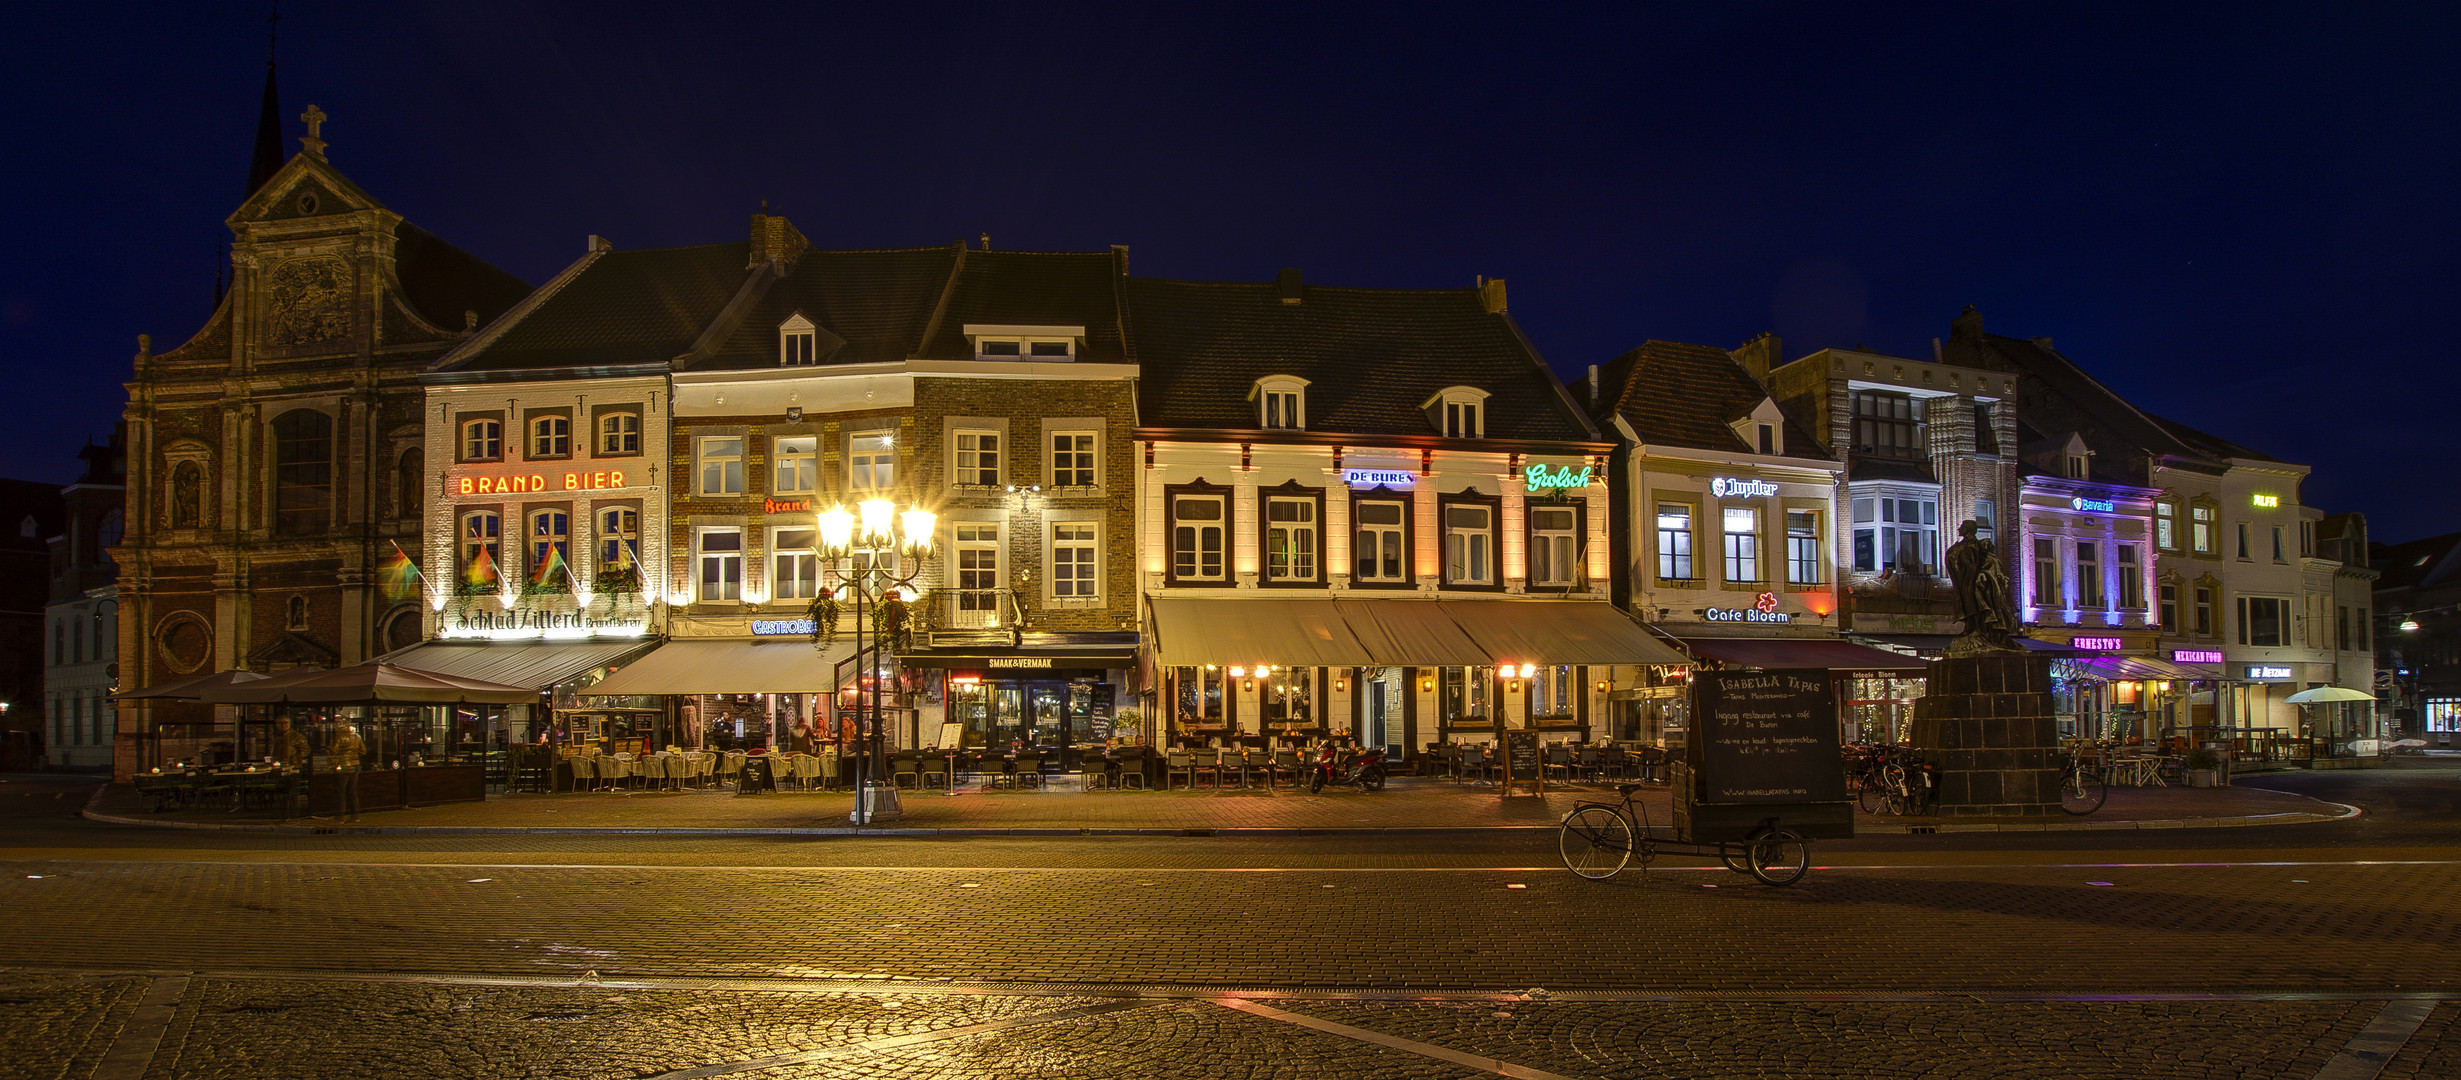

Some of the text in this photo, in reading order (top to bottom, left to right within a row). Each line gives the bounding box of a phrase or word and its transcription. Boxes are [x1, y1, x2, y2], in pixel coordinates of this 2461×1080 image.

[460, 471, 625, 494] BRAND BIER
[1350, 472, 1414, 482] DE BUREN
[1526, 463, 1592, 491] Grolsch
[1726, 479, 1778, 498] Jupiler
[765, 498, 811, 514] Brand
[2082, 499, 2114, 512] Bavaria
[2254, 494, 2278, 507] ALFA
[1707, 608, 1788, 622] Cafe Bloem
[1889, 616, 1935, 630] MEDS
[2074, 637, 2121, 650] ERNESTO'S
[989, 658, 1052, 668] SMAAK&VERMAAK
[2175, 651, 2222, 663] MEXICAN FOOD
[1717, 676, 1821, 692] ISABELLA TAPAS
